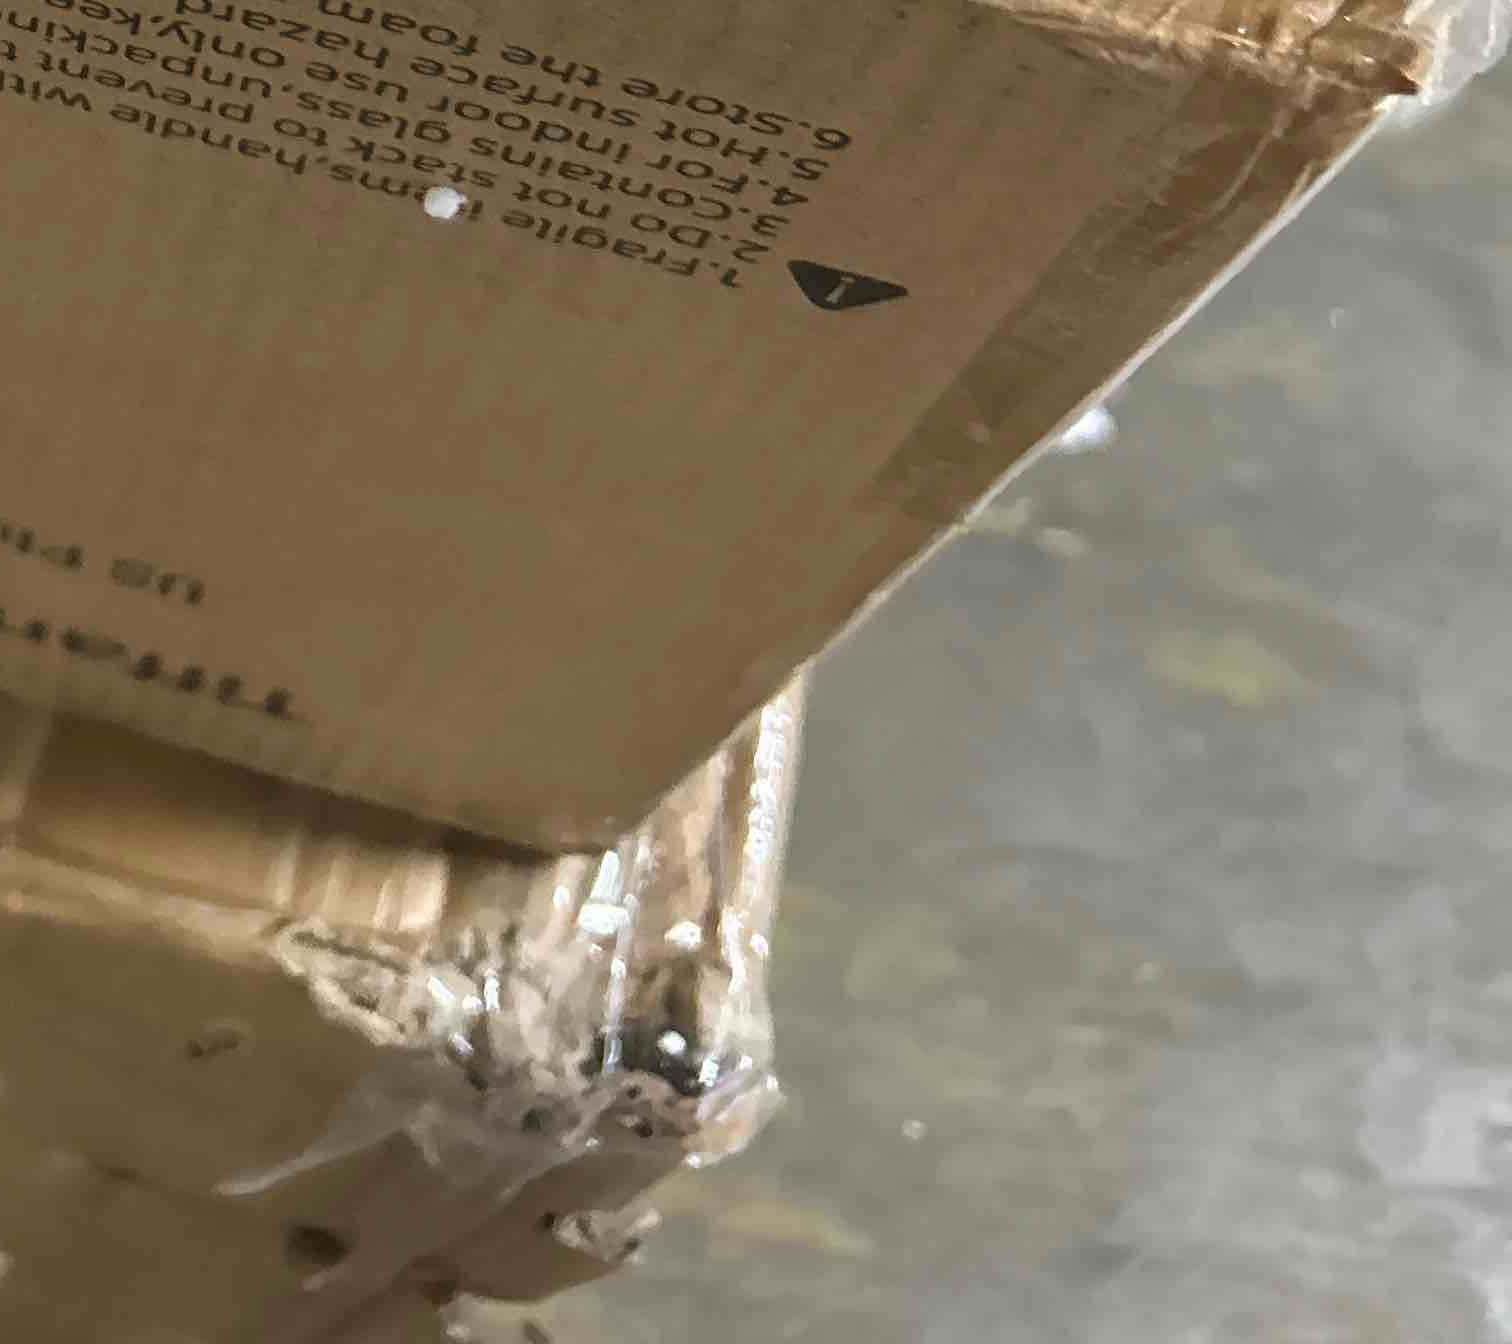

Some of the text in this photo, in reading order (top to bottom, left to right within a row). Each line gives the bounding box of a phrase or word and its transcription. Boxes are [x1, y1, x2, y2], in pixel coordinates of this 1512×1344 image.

[37, 49, 255, 125] prevent
[303, 60, 410, 104] use
[408, 55, 642, 129] surface
[499, 44, 602, 90] the
[271, 115, 329, 149] to
[426, 93, 632, 166] indoor
[619, 76, 853, 152] 6.Store
[343, 135, 498, 190] stack
[644, 151, 810, 208] 4.For
[653, 118, 829, 183] 5.Hot
[468, 136, 791, 239] 3.Contains
[511, 180, 612, 222] not
[500, 208, 741, 290] 1.Fragile
[628, 212, 771, 265] 2.Do
